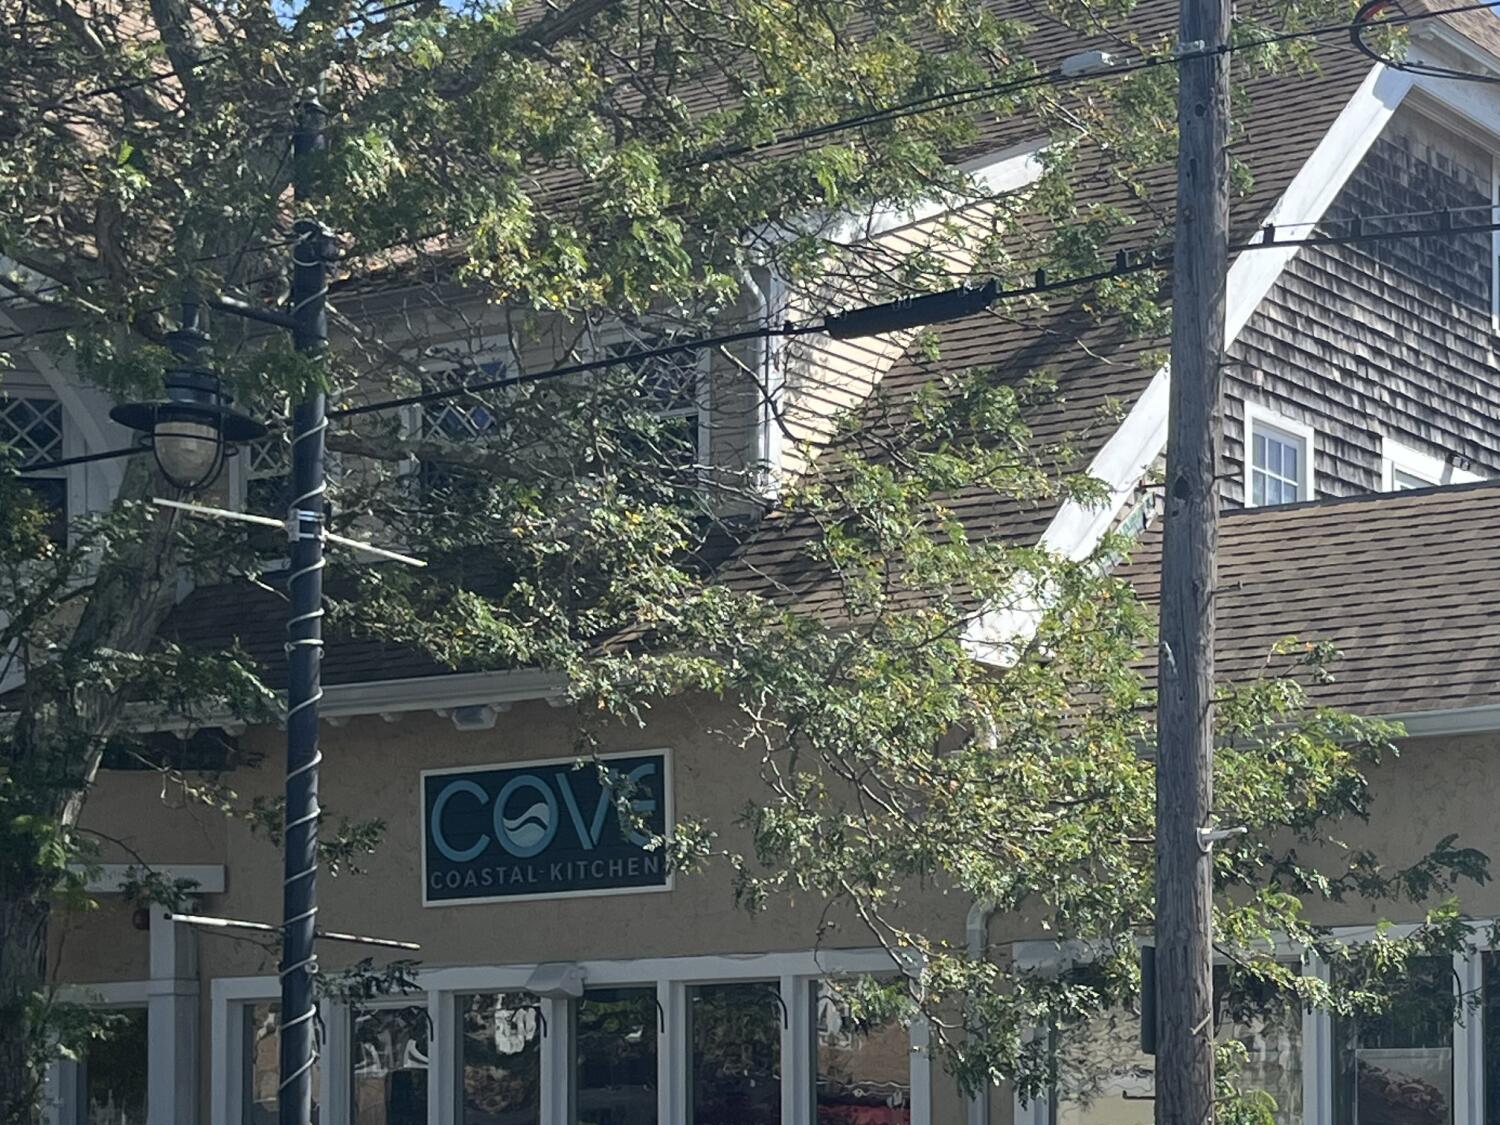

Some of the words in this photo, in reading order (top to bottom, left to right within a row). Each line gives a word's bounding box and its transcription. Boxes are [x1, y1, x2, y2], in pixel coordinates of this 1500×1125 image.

[431, 763, 656, 862] COVE
[430, 865, 538, 889] COASTAL
[550, 855, 659, 881] KITCHEN
